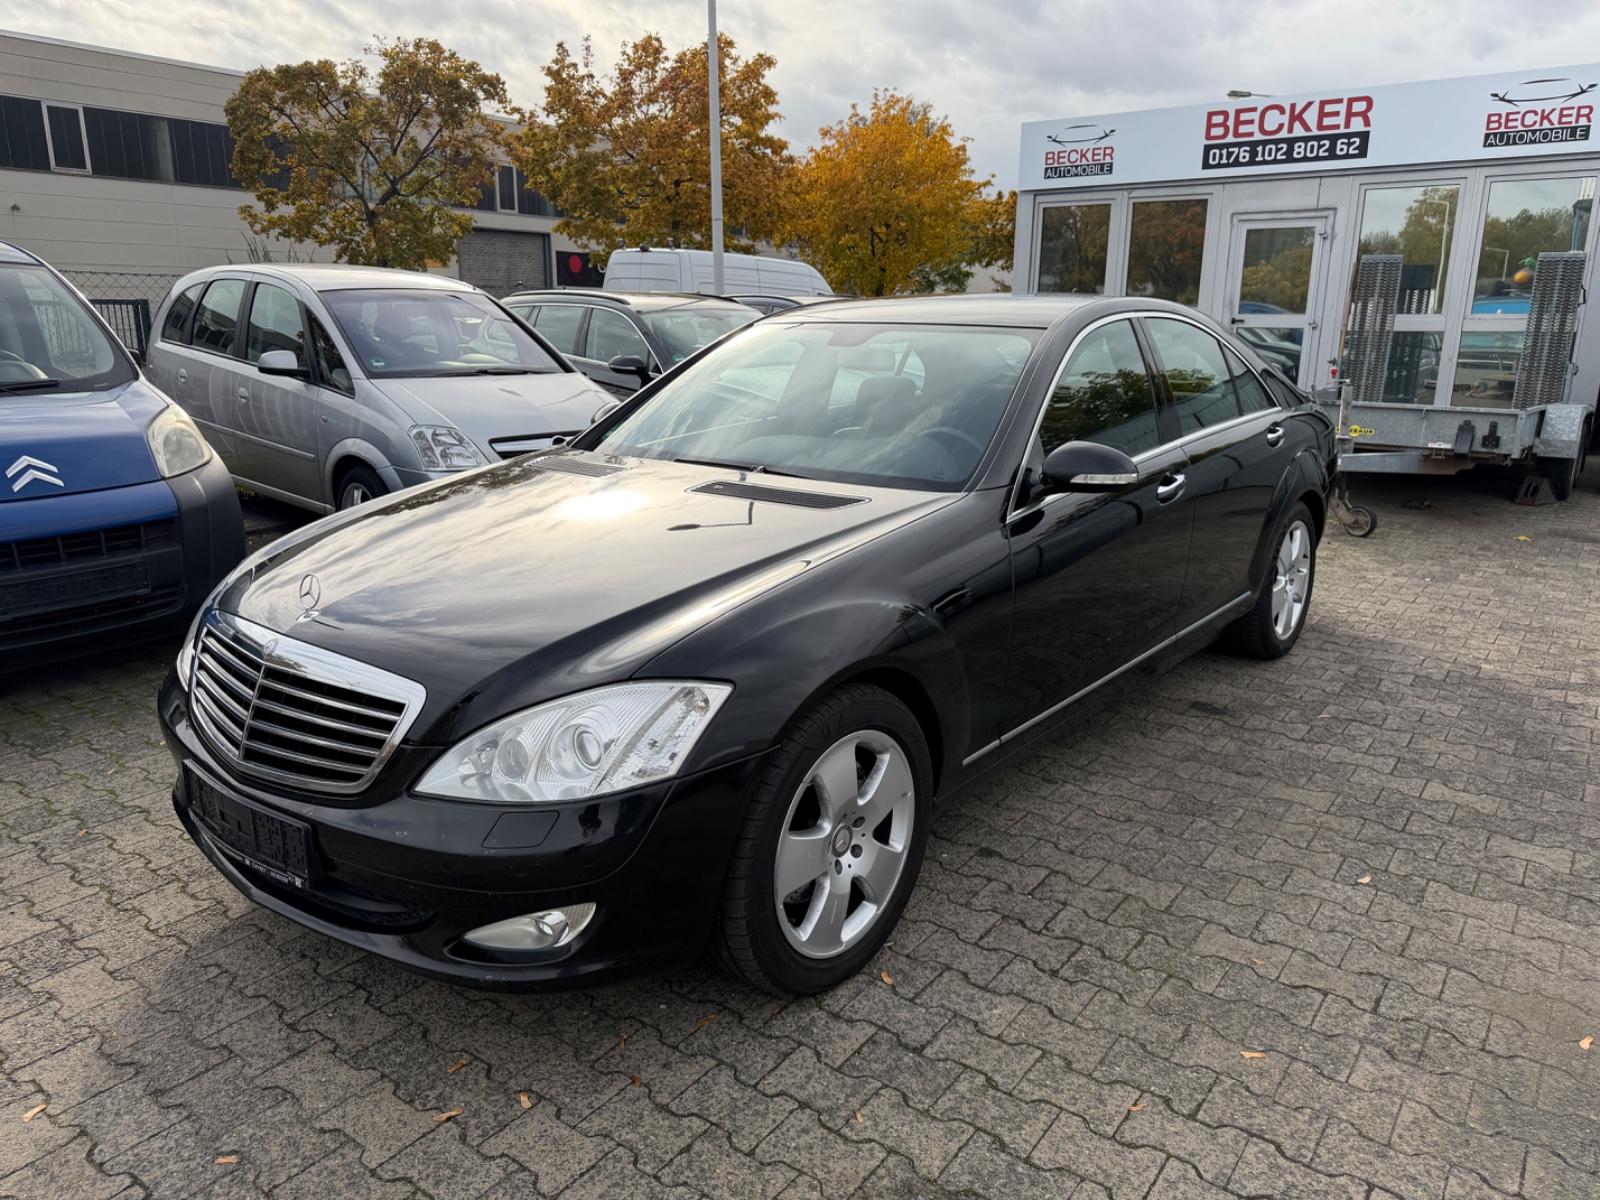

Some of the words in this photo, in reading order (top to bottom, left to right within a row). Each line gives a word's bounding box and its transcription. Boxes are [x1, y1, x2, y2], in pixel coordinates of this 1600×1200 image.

[1204, 95, 1374, 141] BECKER
[1485, 104, 1594, 131] BECKER
[1485, 127, 1587, 146] AUTOMOBILE
[1044, 146, 1115, 166] BECKER
[1208, 146, 1250, 165] 0176
[1255, 143, 1288, 161] 102
[1293, 139, 1330, 159] 802
[1335, 137, 1360, 155] 62
[1045, 163, 1111, 178] AUTOMOBILE
